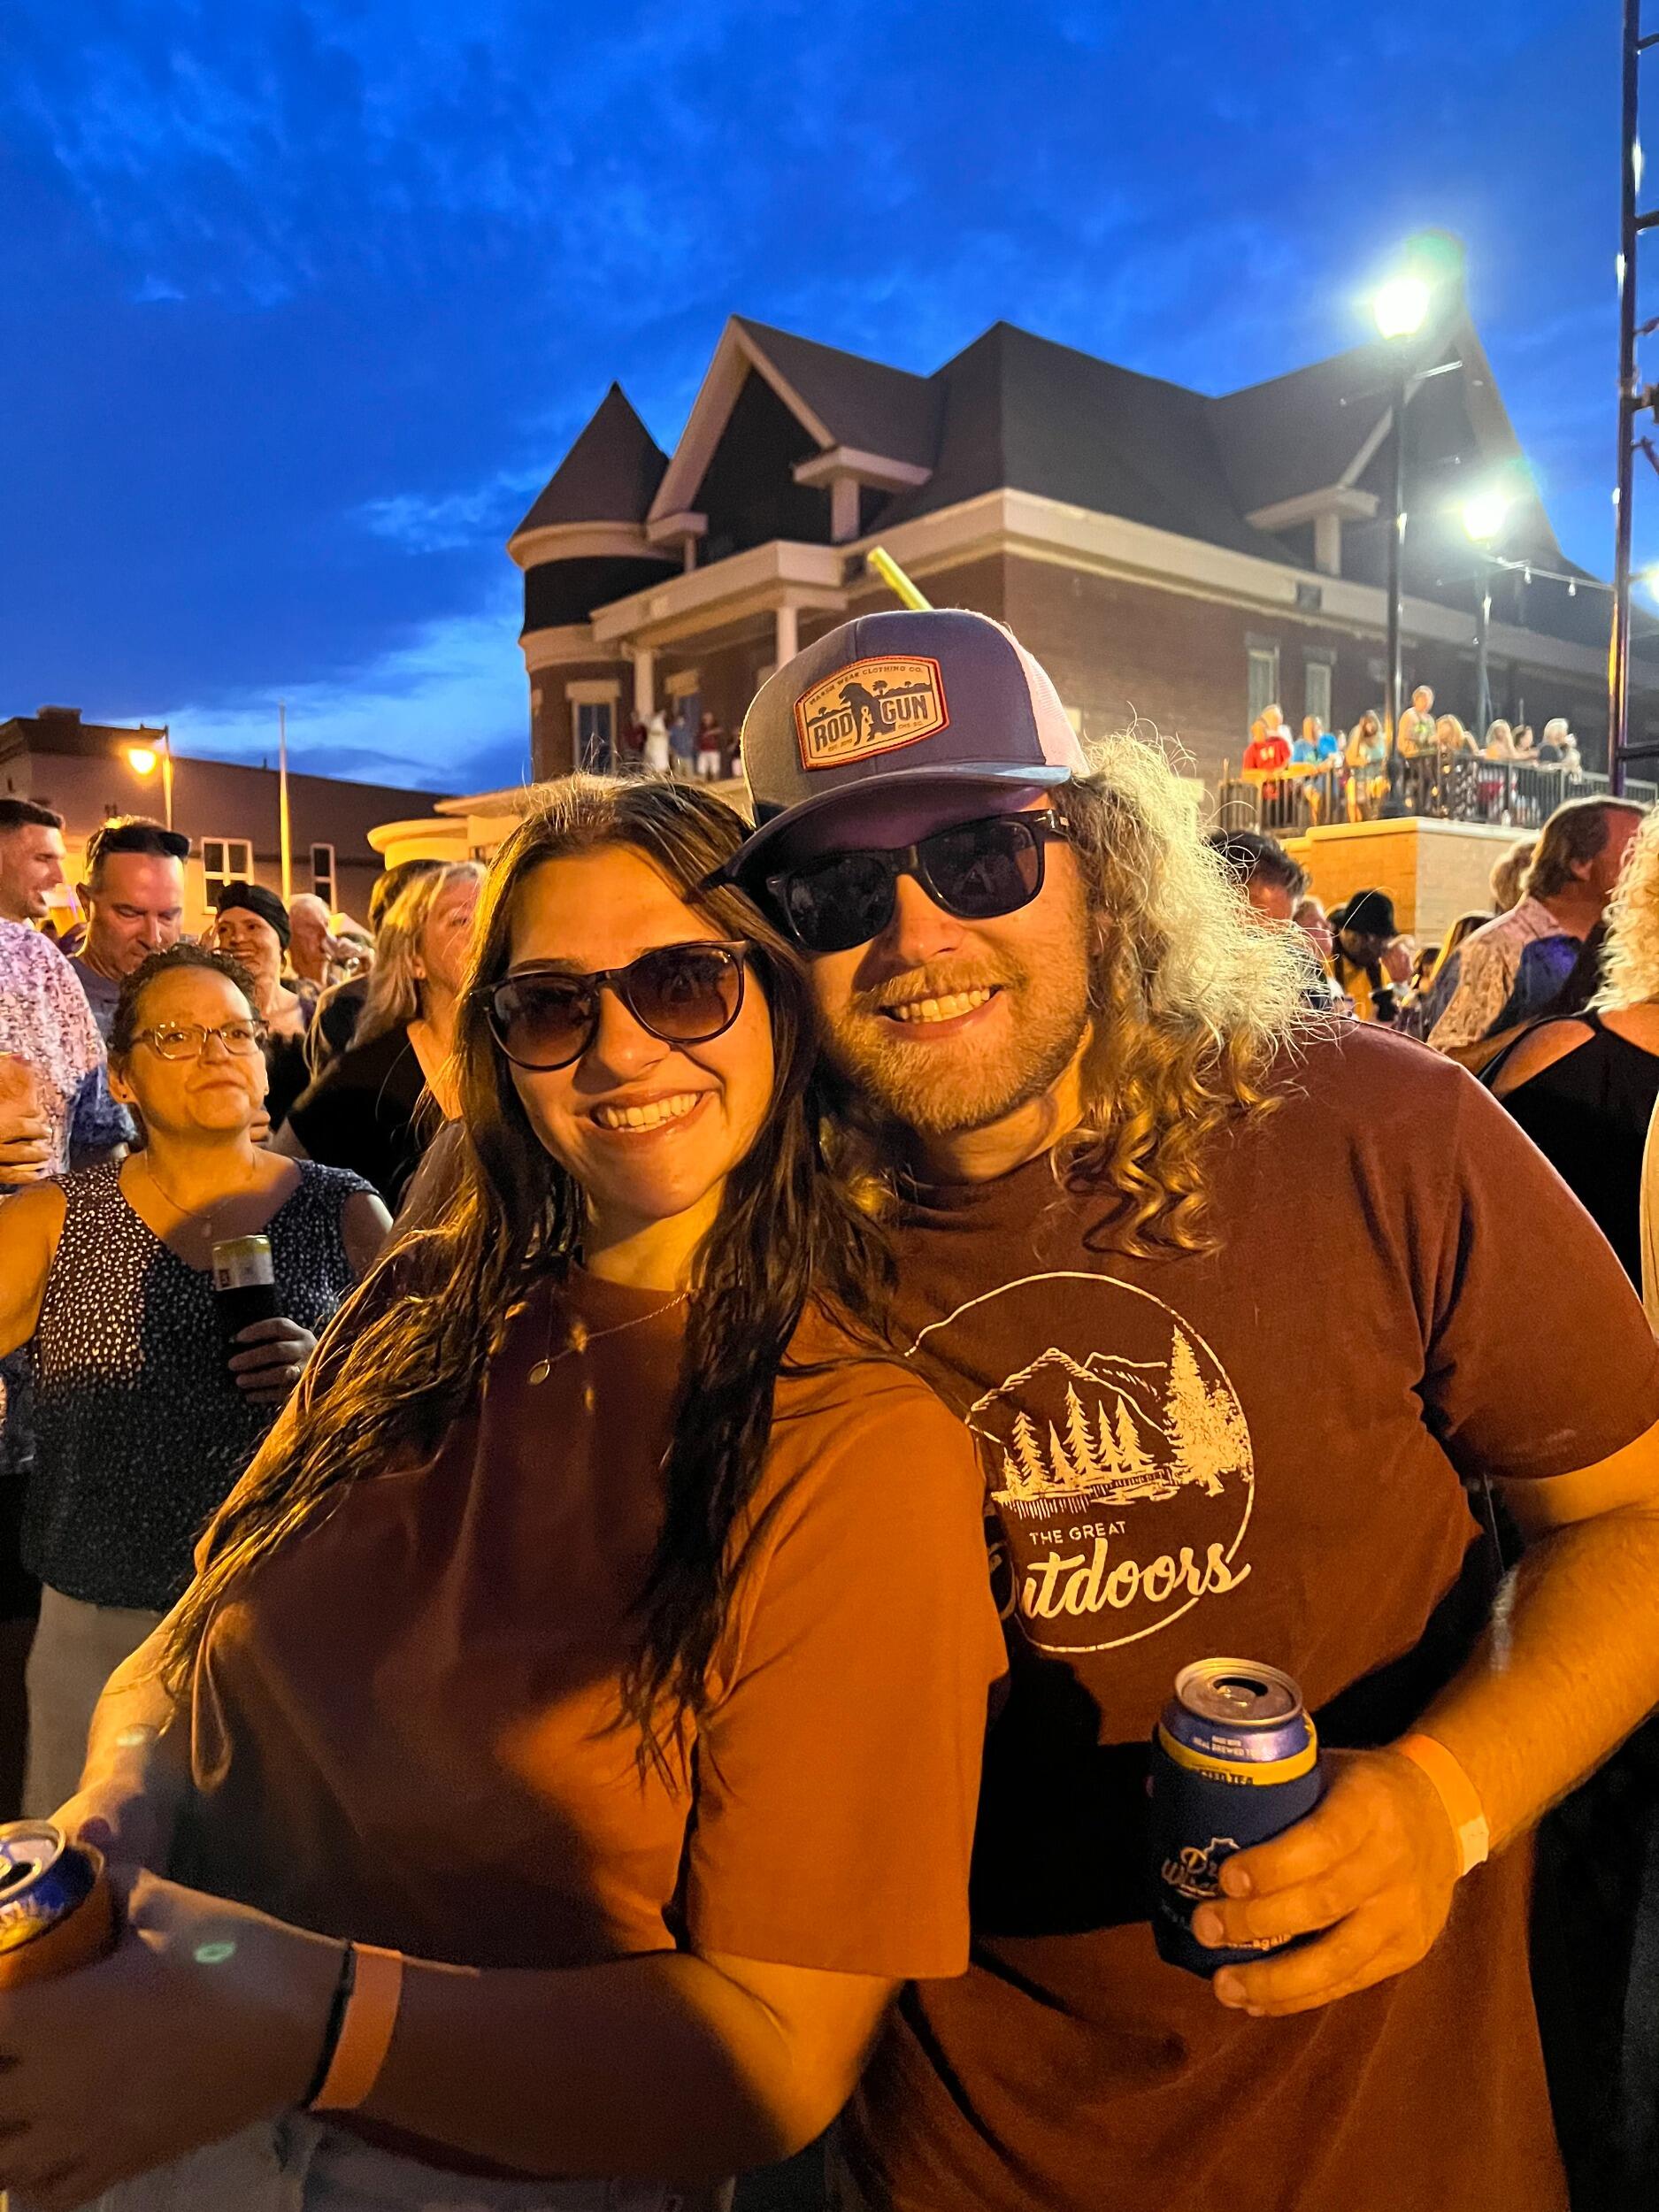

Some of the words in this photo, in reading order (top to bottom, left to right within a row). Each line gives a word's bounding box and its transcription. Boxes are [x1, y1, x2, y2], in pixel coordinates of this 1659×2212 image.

[862, 665, 906, 675] CLOTHING
[813, 712, 854, 752] ROD
[882, 695, 929, 722] GUN
[1029, 1529, 1064, 1546] THE
[1069, 1520, 1126, 1541] GREAT
